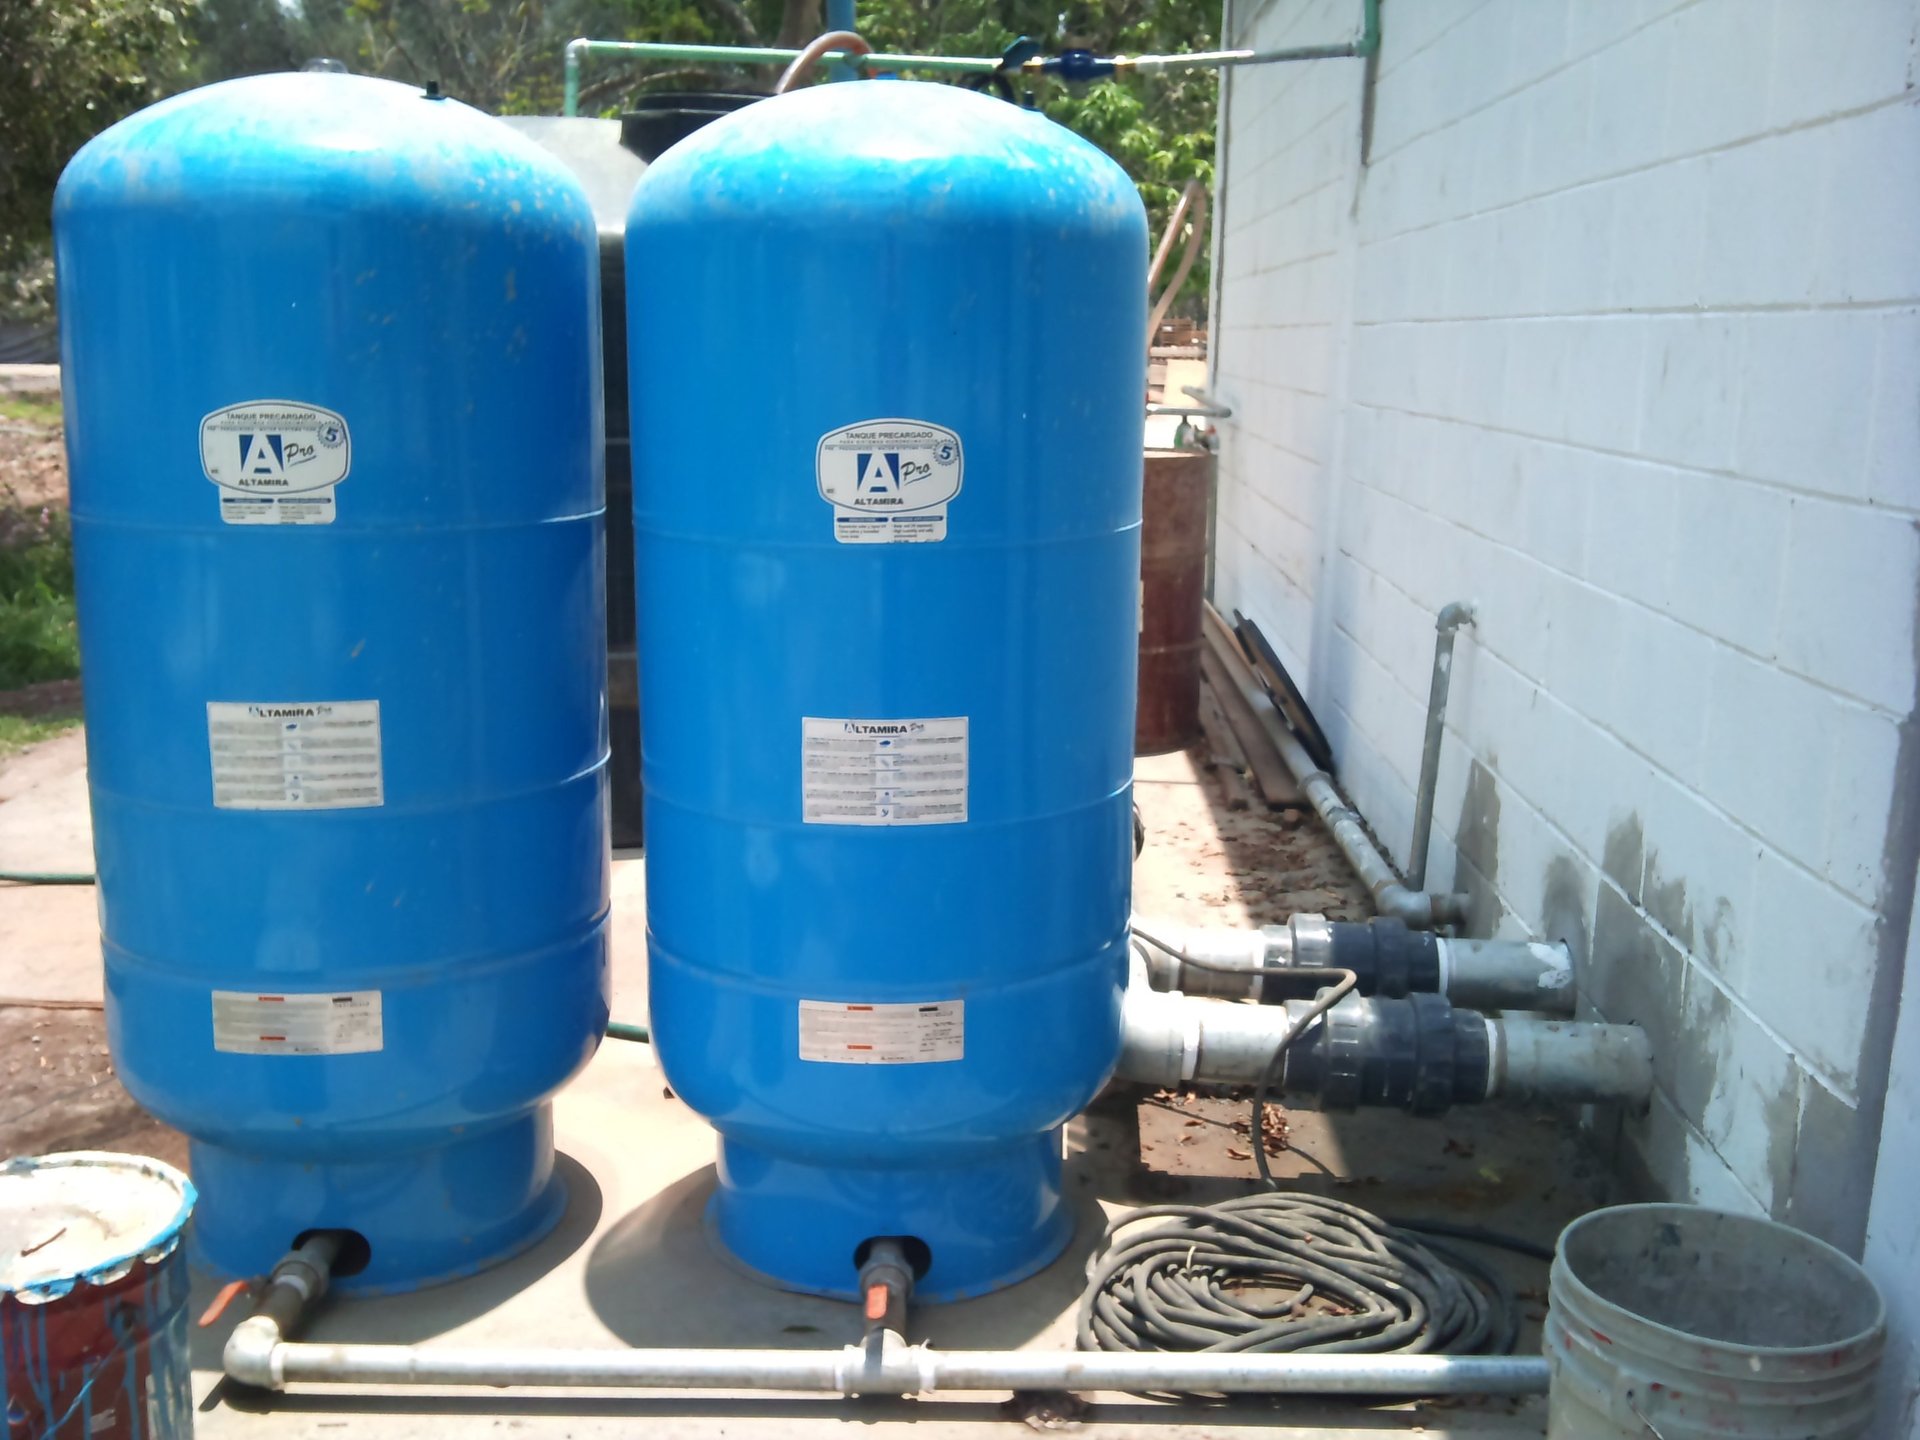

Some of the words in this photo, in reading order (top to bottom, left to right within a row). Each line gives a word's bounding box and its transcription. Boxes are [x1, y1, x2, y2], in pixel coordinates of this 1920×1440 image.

[226, 413, 257, 421] TANQUE
[259, 413, 316, 421] PRECARGADO
[325, 426, 339, 443] 5
[878, 431, 934, 439] PRECARGADO
[284, 442, 315, 463] Pro
[939, 445, 953, 460] 5
[900, 461, 931, 481] Pro
[238, 478, 289, 487] ALTAMIRA
[854, 497, 904, 506] ALTAMIRA
[844, 722, 908, 734] ALTAMIRA
